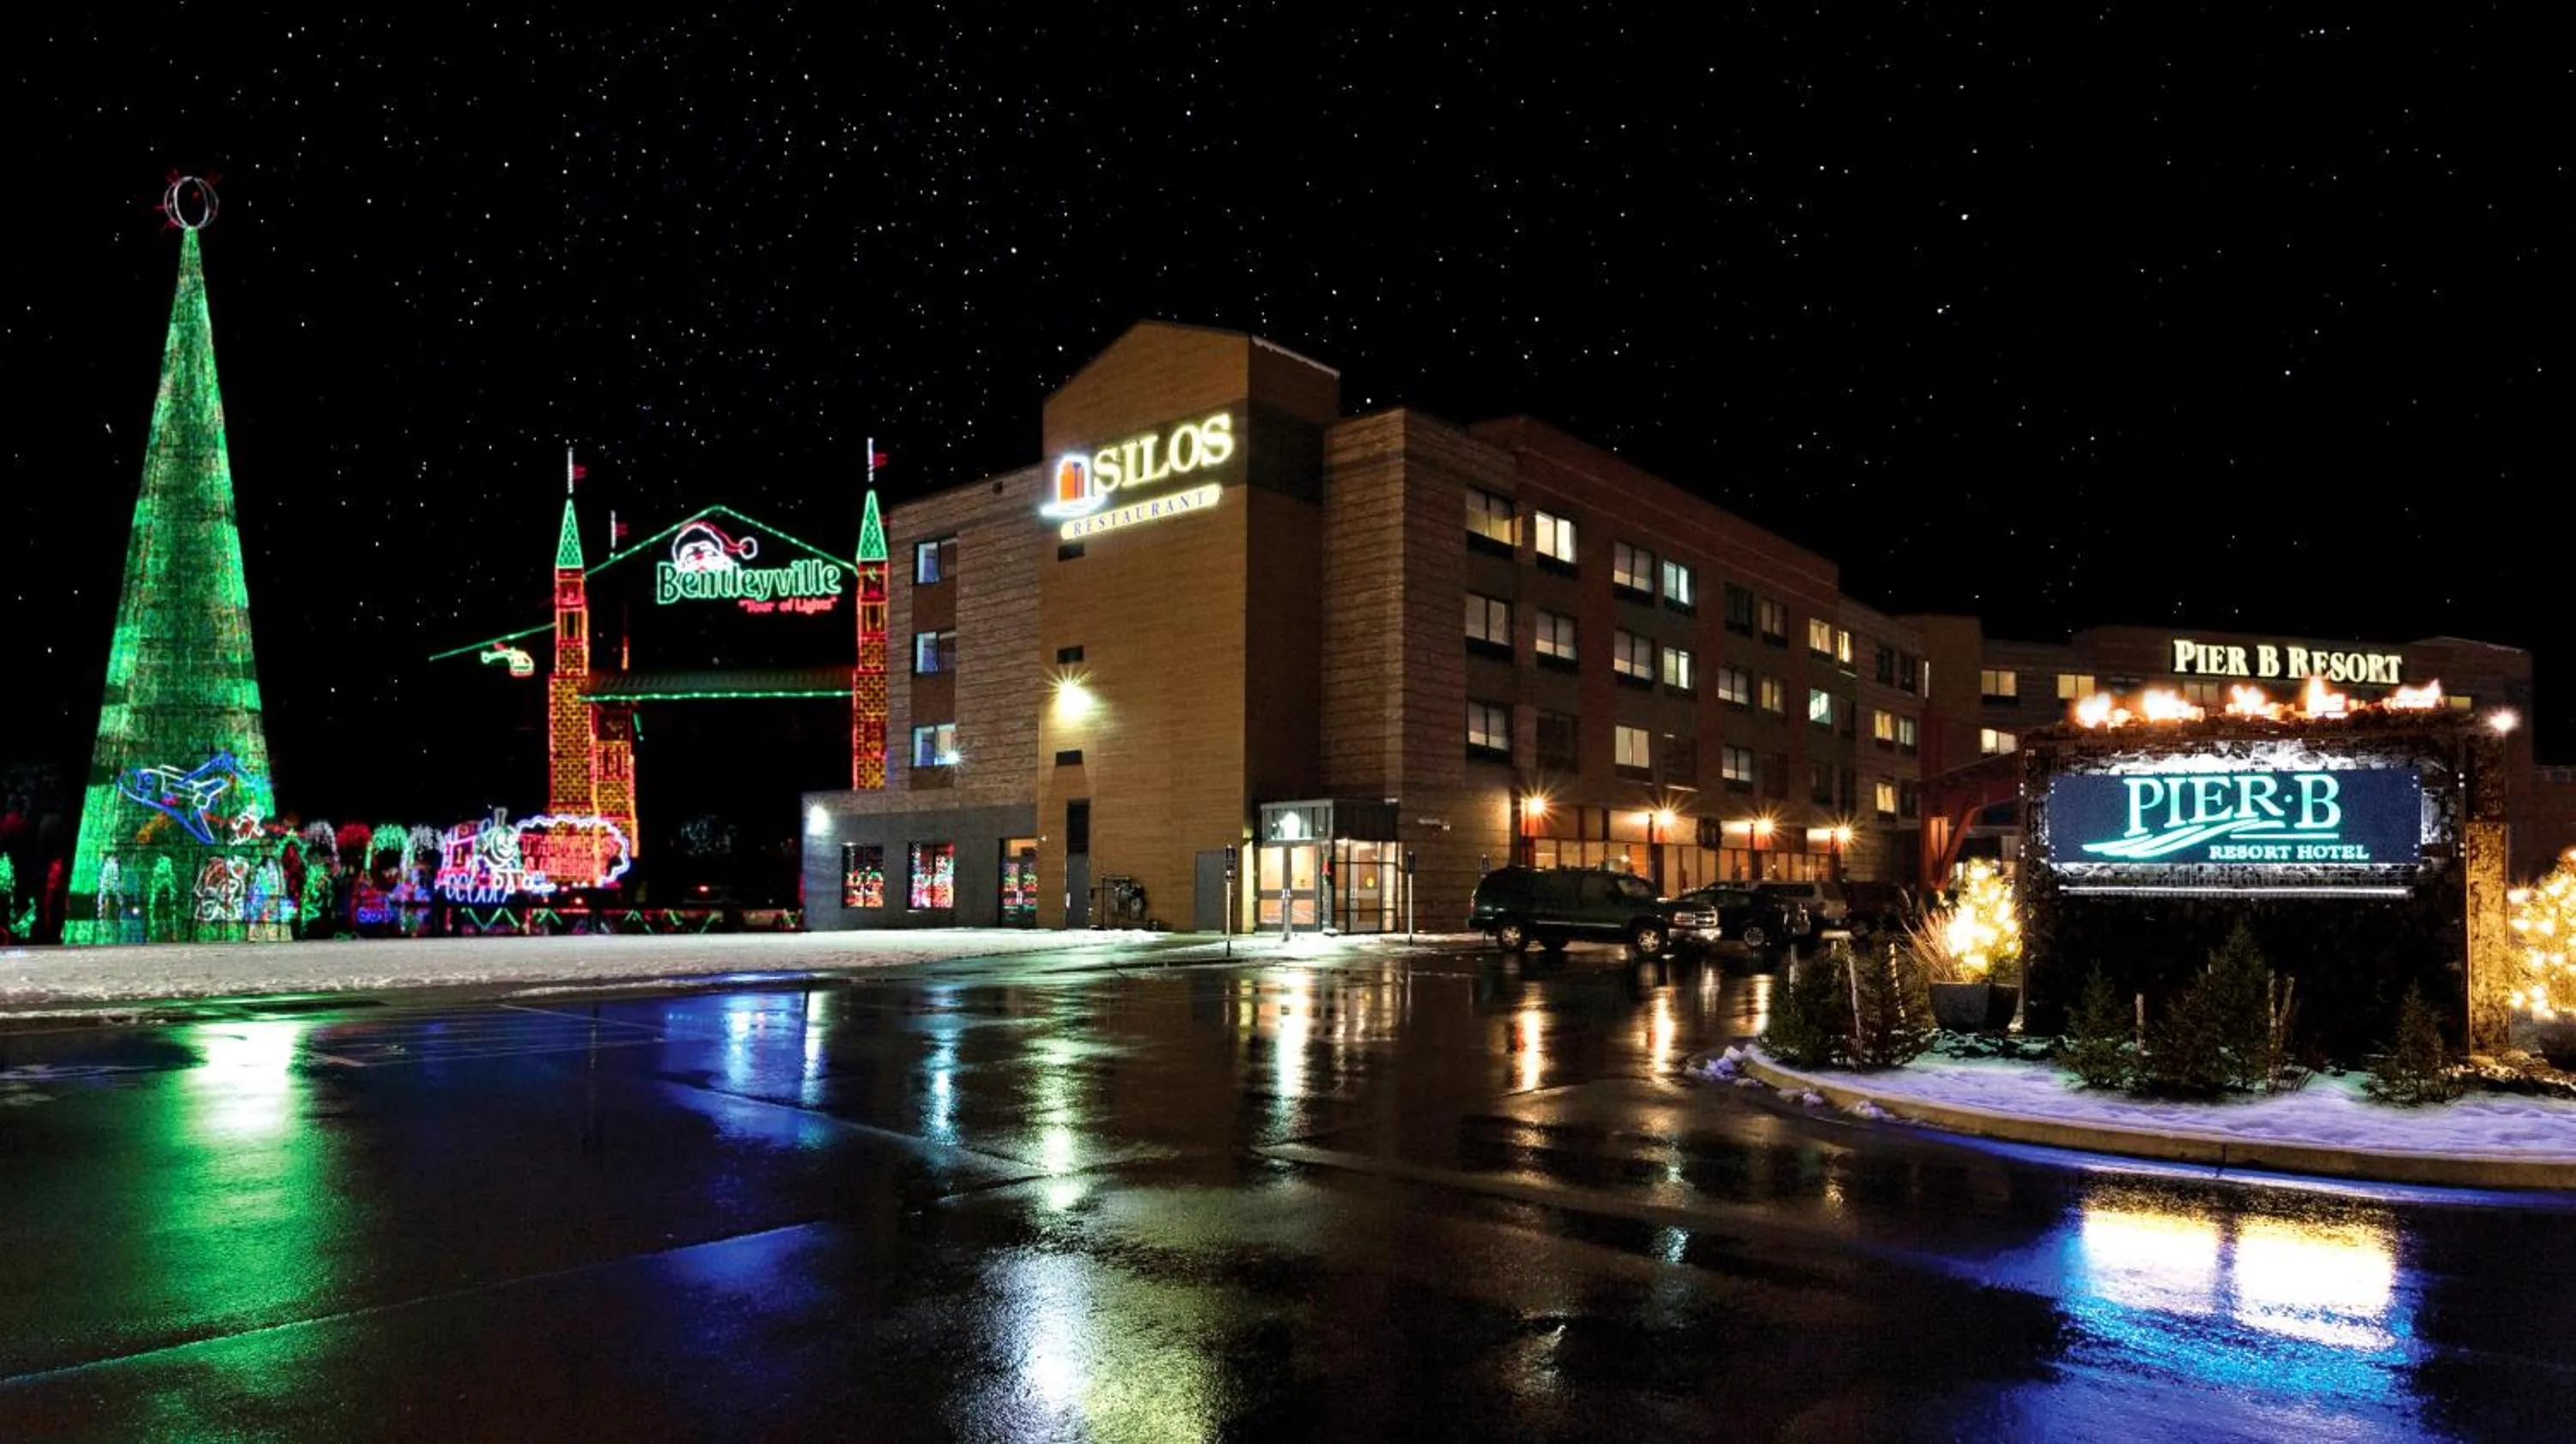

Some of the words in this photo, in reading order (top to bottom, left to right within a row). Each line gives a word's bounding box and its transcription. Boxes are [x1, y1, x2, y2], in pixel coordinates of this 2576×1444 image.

[1093, 413, 1234, 493] SILOS
[1073, 490, 1206, 536] RESTAURANT
[656, 558, 841, 604] Bentleyville
[2173, 640, 2250, 676] PIER
[2257, 644, 2281, 678] B
[2287, 646, 2403, 684] RESORT
[2209, 844, 2293, 861] RESORT
[2296, 844, 2371, 861] HOTEL
